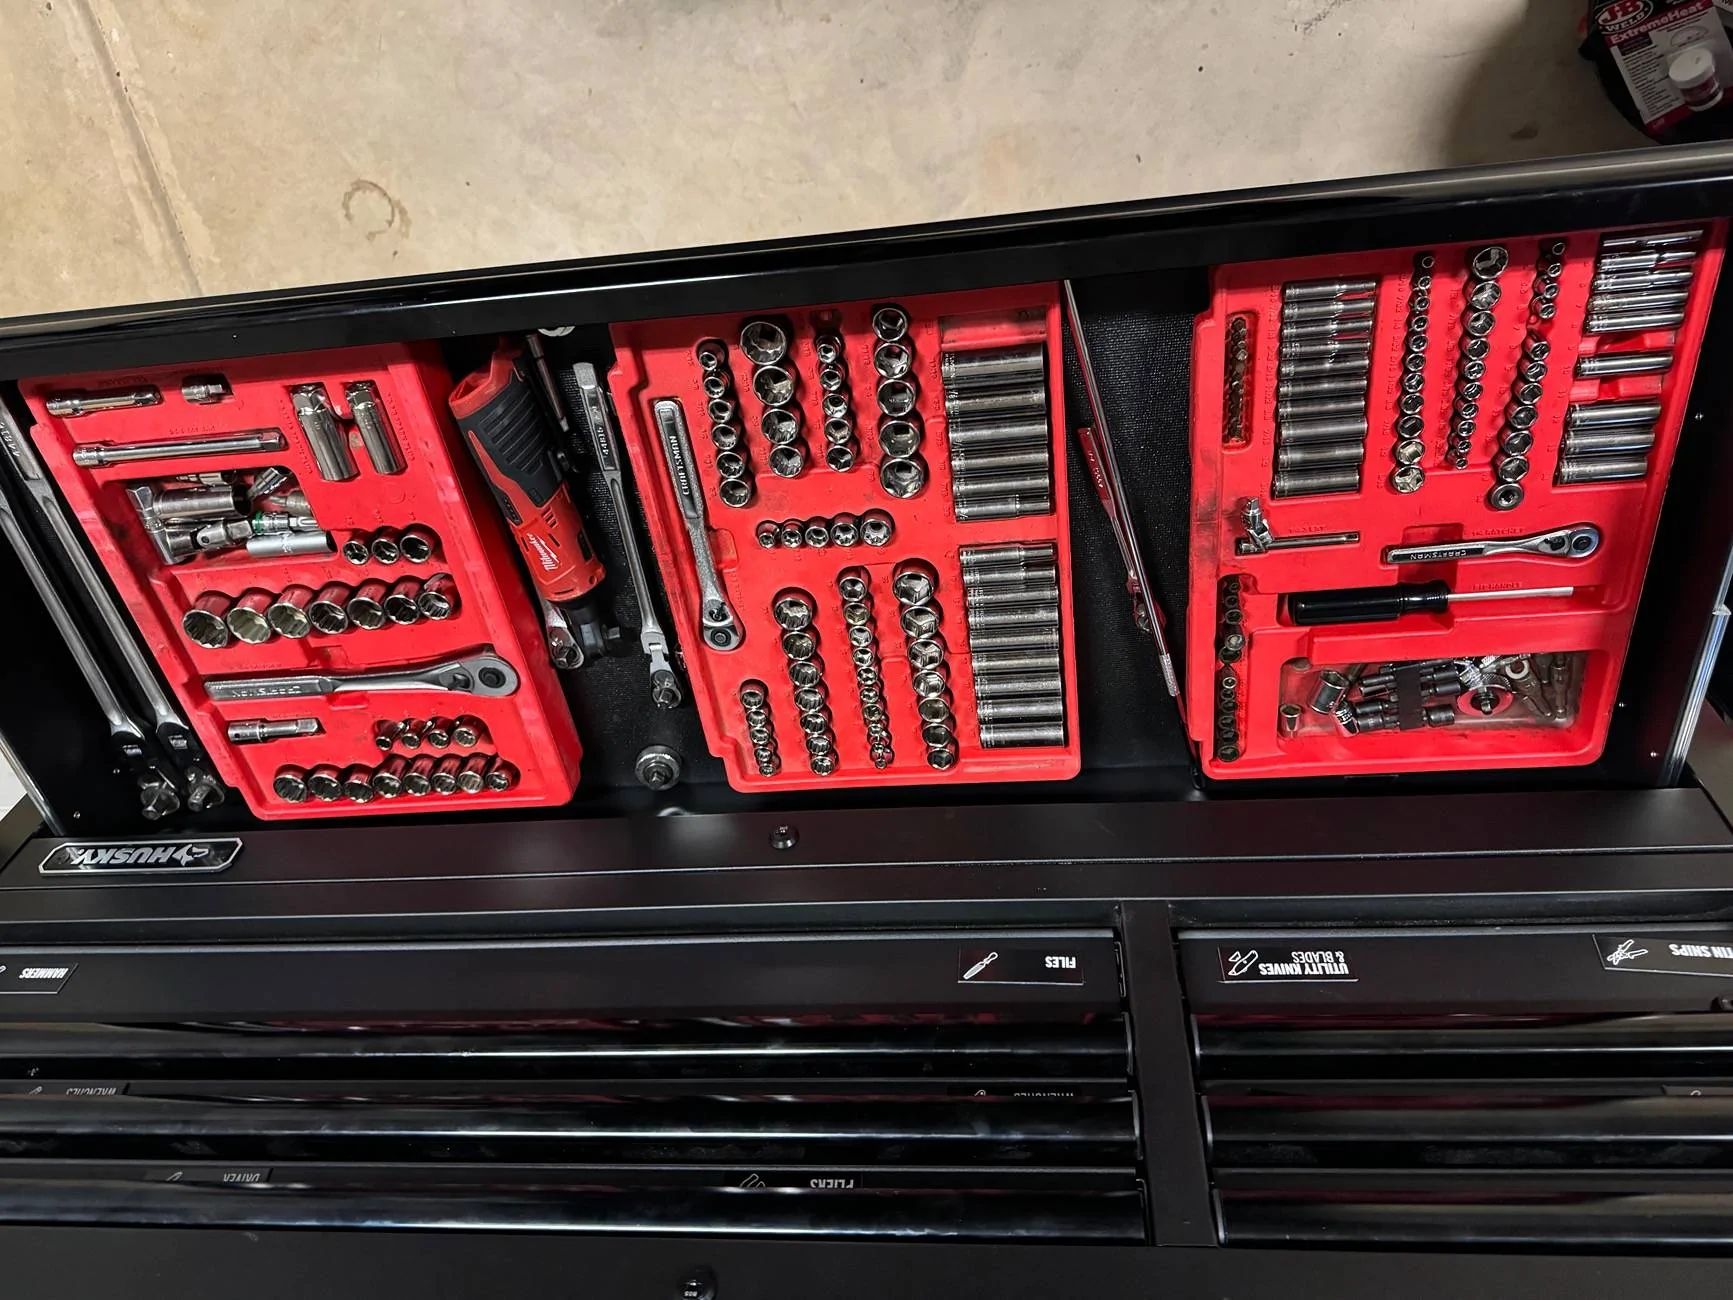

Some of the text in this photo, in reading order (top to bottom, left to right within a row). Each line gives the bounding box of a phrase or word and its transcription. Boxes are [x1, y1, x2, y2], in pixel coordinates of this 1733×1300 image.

[1605, 11, 1645, 31] WELD
[1610, 2, 1704, 43] ExtremeHeat
[669, 435, 690, 495] CRAFTSMAN
[526, 533, 559, 571] Milwaukee
[1409, 549, 1467, 561] CRAFTSMAN
[69, 846, 177, 865] HUSKY
[1291, 951, 1345, 963] & BLADES
[1668, 943, 1712, 958] SNIPS
[1045, 956, 1077, 969] FILES
[1258, 962, 1349, 976] UTILITY KNIVES
[19, 967, 69, 979] HAMMERS
